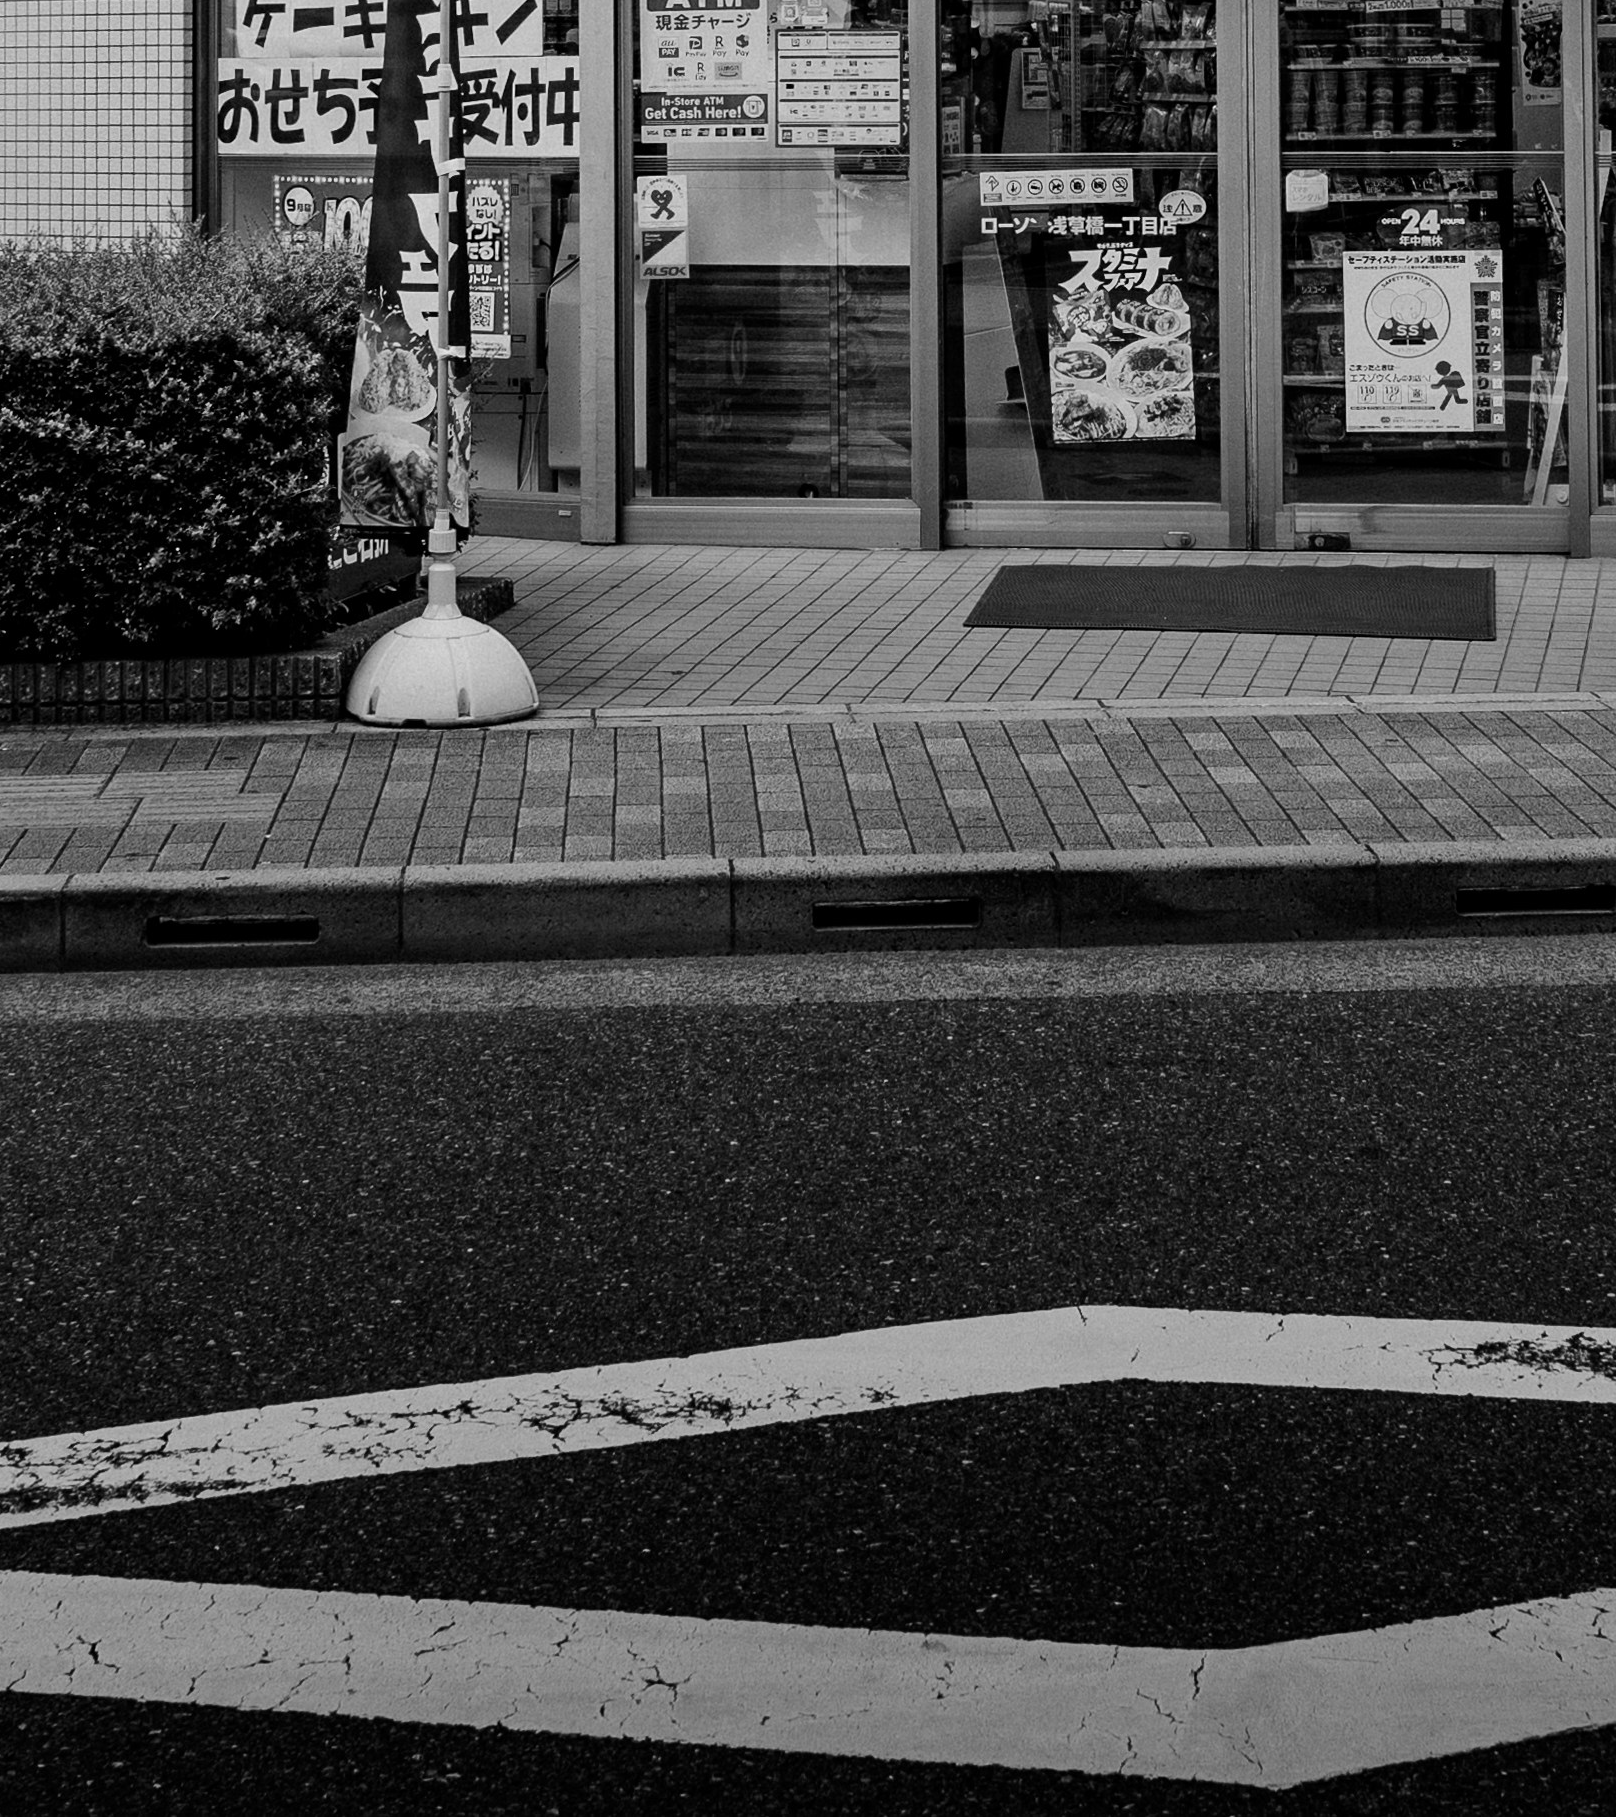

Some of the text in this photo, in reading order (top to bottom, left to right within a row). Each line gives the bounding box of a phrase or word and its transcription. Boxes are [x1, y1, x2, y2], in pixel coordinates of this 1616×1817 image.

[656, 12, 752, 31] 現金チャージ
[713, 50, 727, 58] Pay
[661, 96, 724, 107] In-Store ATM
[645, 105, 742, 119] Get Cash Here!
[1048, 216, 1178, 235] 浅草橋一丁目店
[1401, 208, 1441, 235] 24
[1441, 217, 1465, 225] HOURS
[1399, 235, 1443, 246] 年中無休
[643, 266, 686, 277] ALSOK
[1380, 275, 1404, 288] SAFETY
[1396, 325, 1420, 336] SS
[1360, 387, 1375, 395] 110
